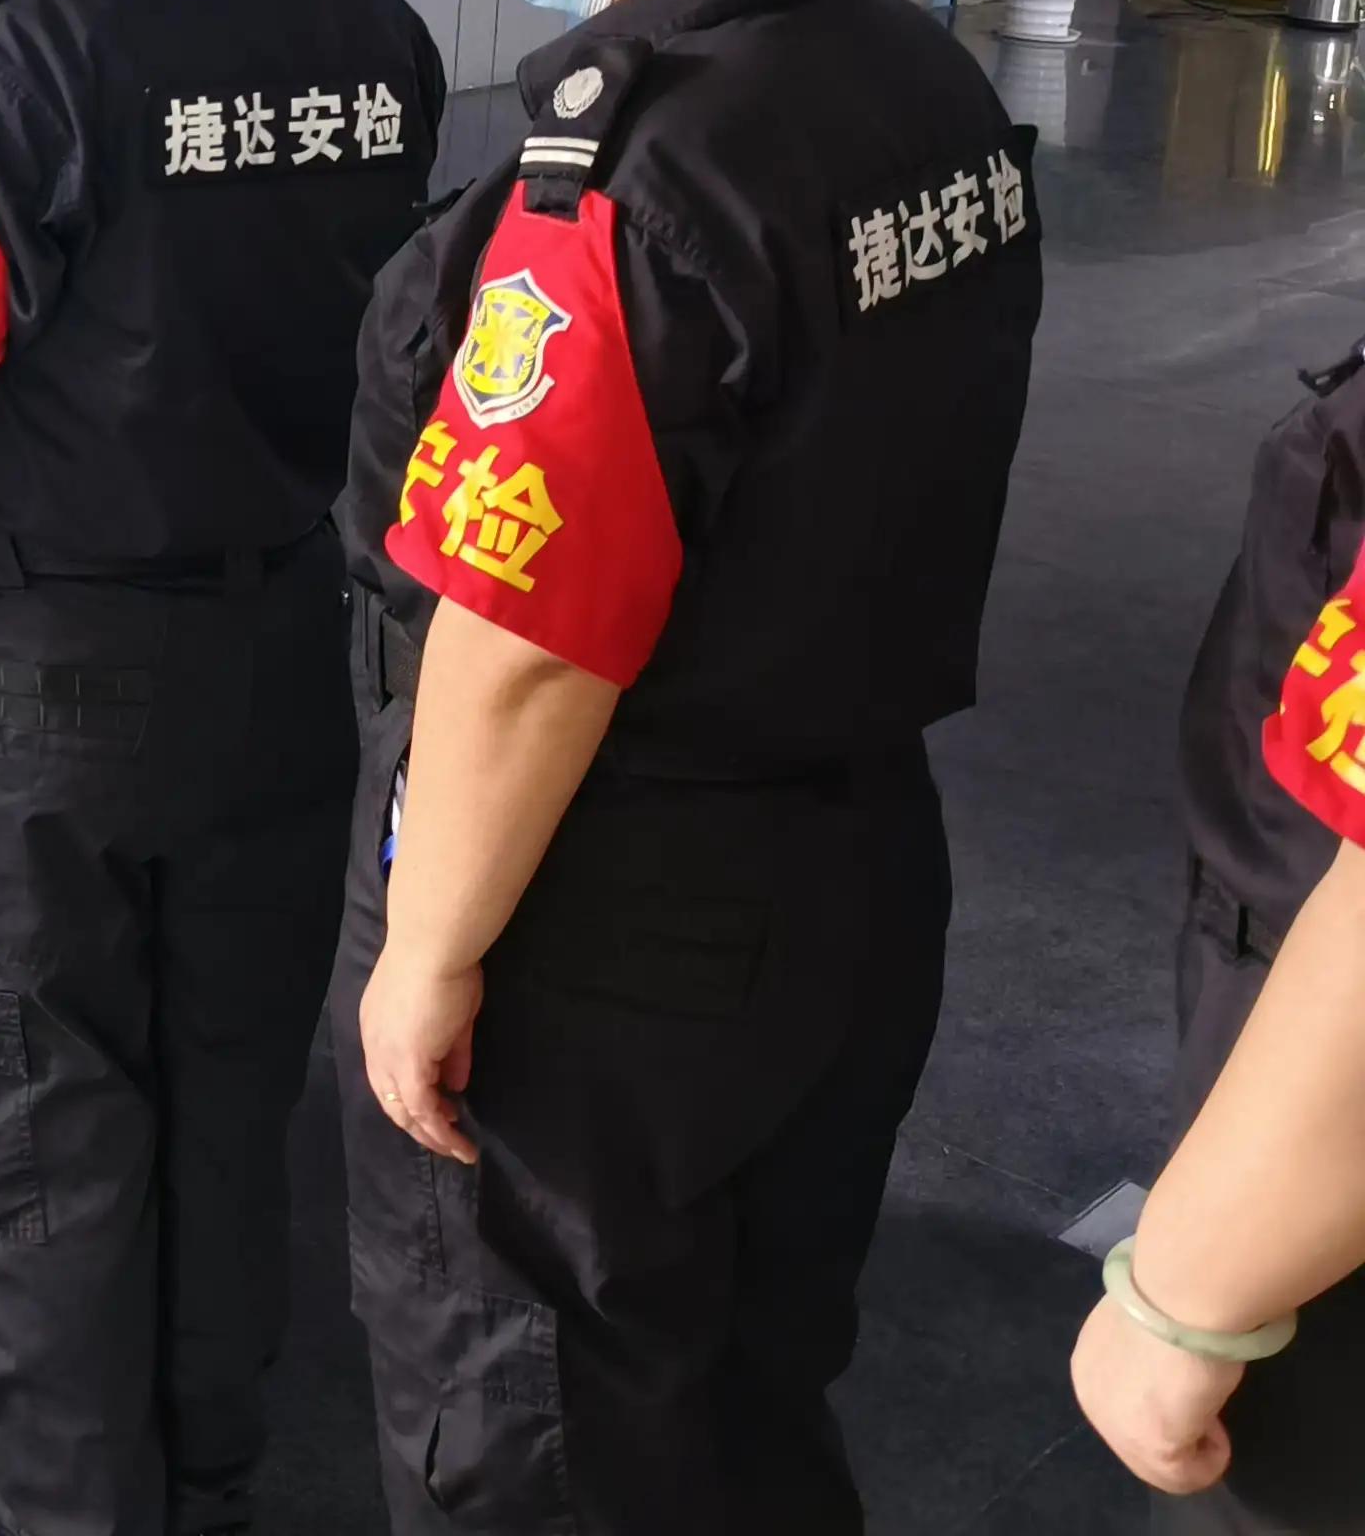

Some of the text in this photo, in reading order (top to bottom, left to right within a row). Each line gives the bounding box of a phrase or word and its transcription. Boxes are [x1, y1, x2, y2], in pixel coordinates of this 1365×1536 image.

[164, 82, 406, 178] 捷达安检
[847, 148, 1025, 313] 捷达安检
